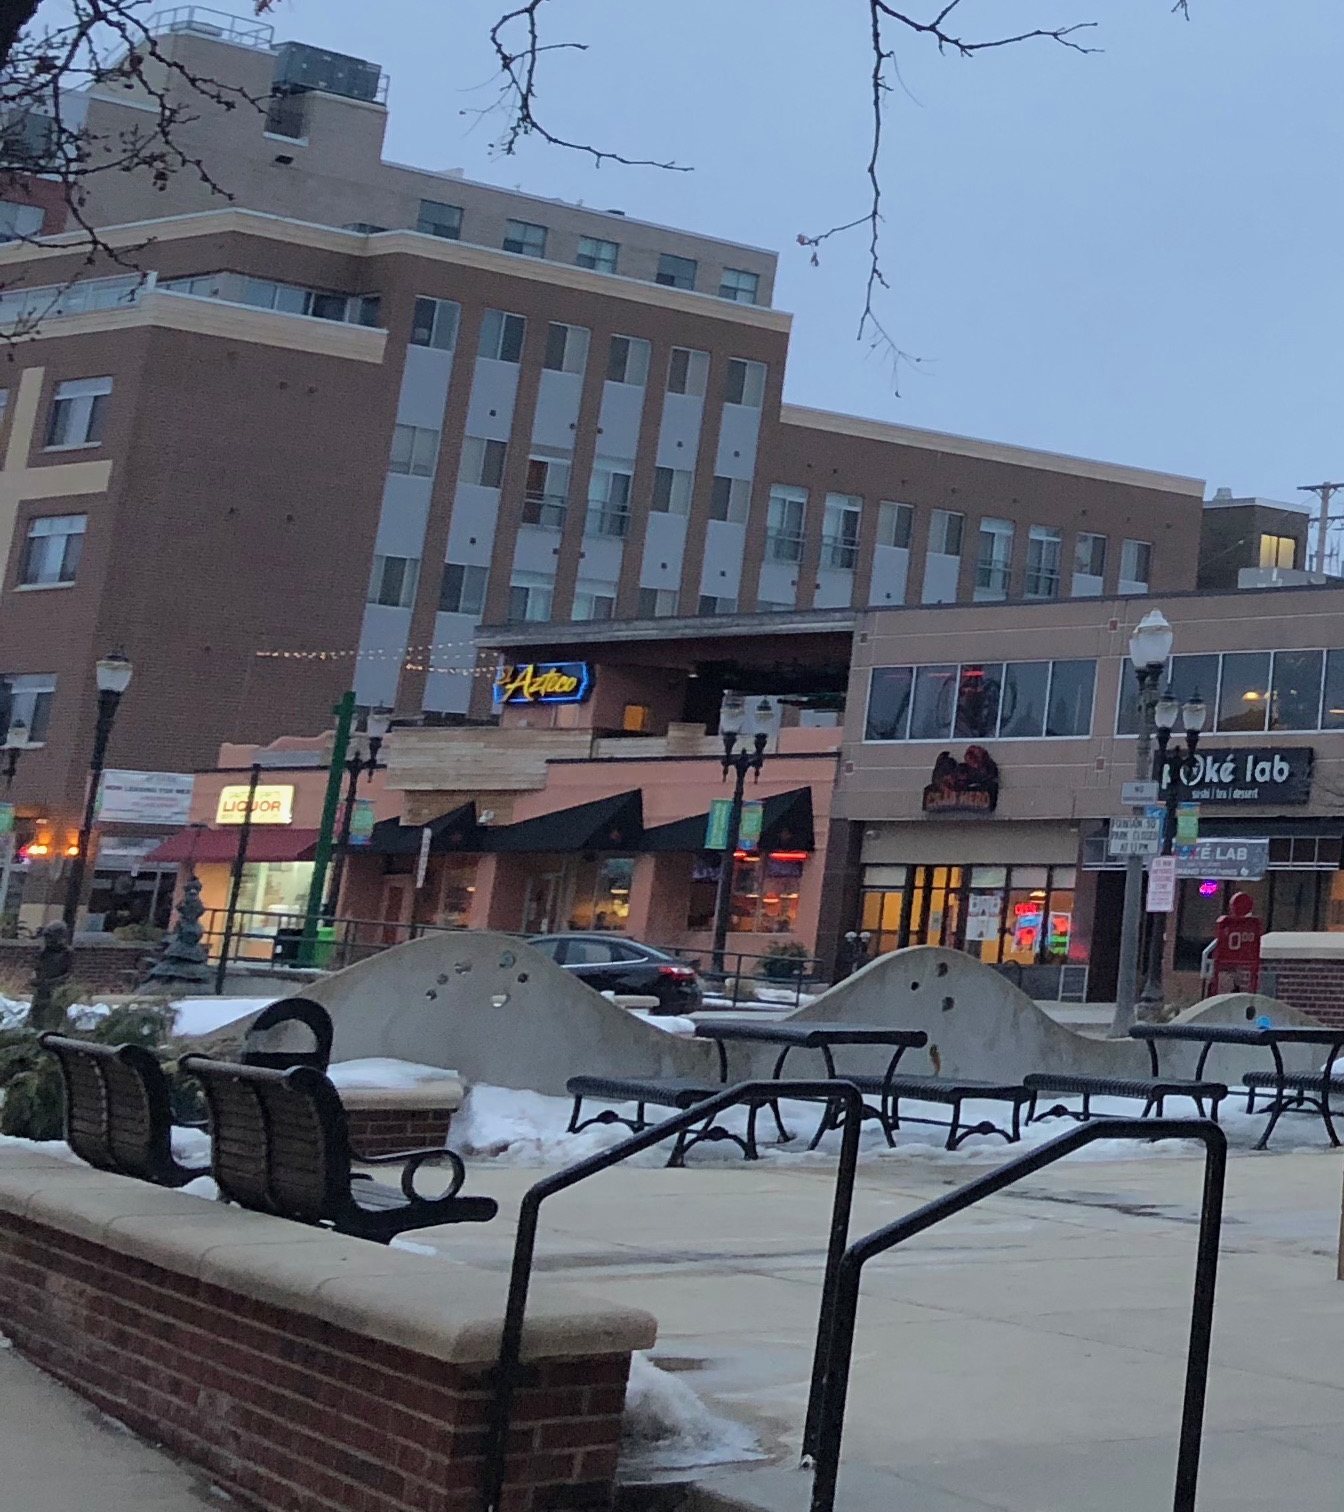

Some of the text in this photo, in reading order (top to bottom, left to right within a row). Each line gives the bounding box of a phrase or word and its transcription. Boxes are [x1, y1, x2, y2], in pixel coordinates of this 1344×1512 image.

[502, 664, 577, 701] Azteco
[1245, 754, 1290, 784] lab
[223, 800, 281, 812] LIQUOR
[1215, 846, 1248, 861] LAB
